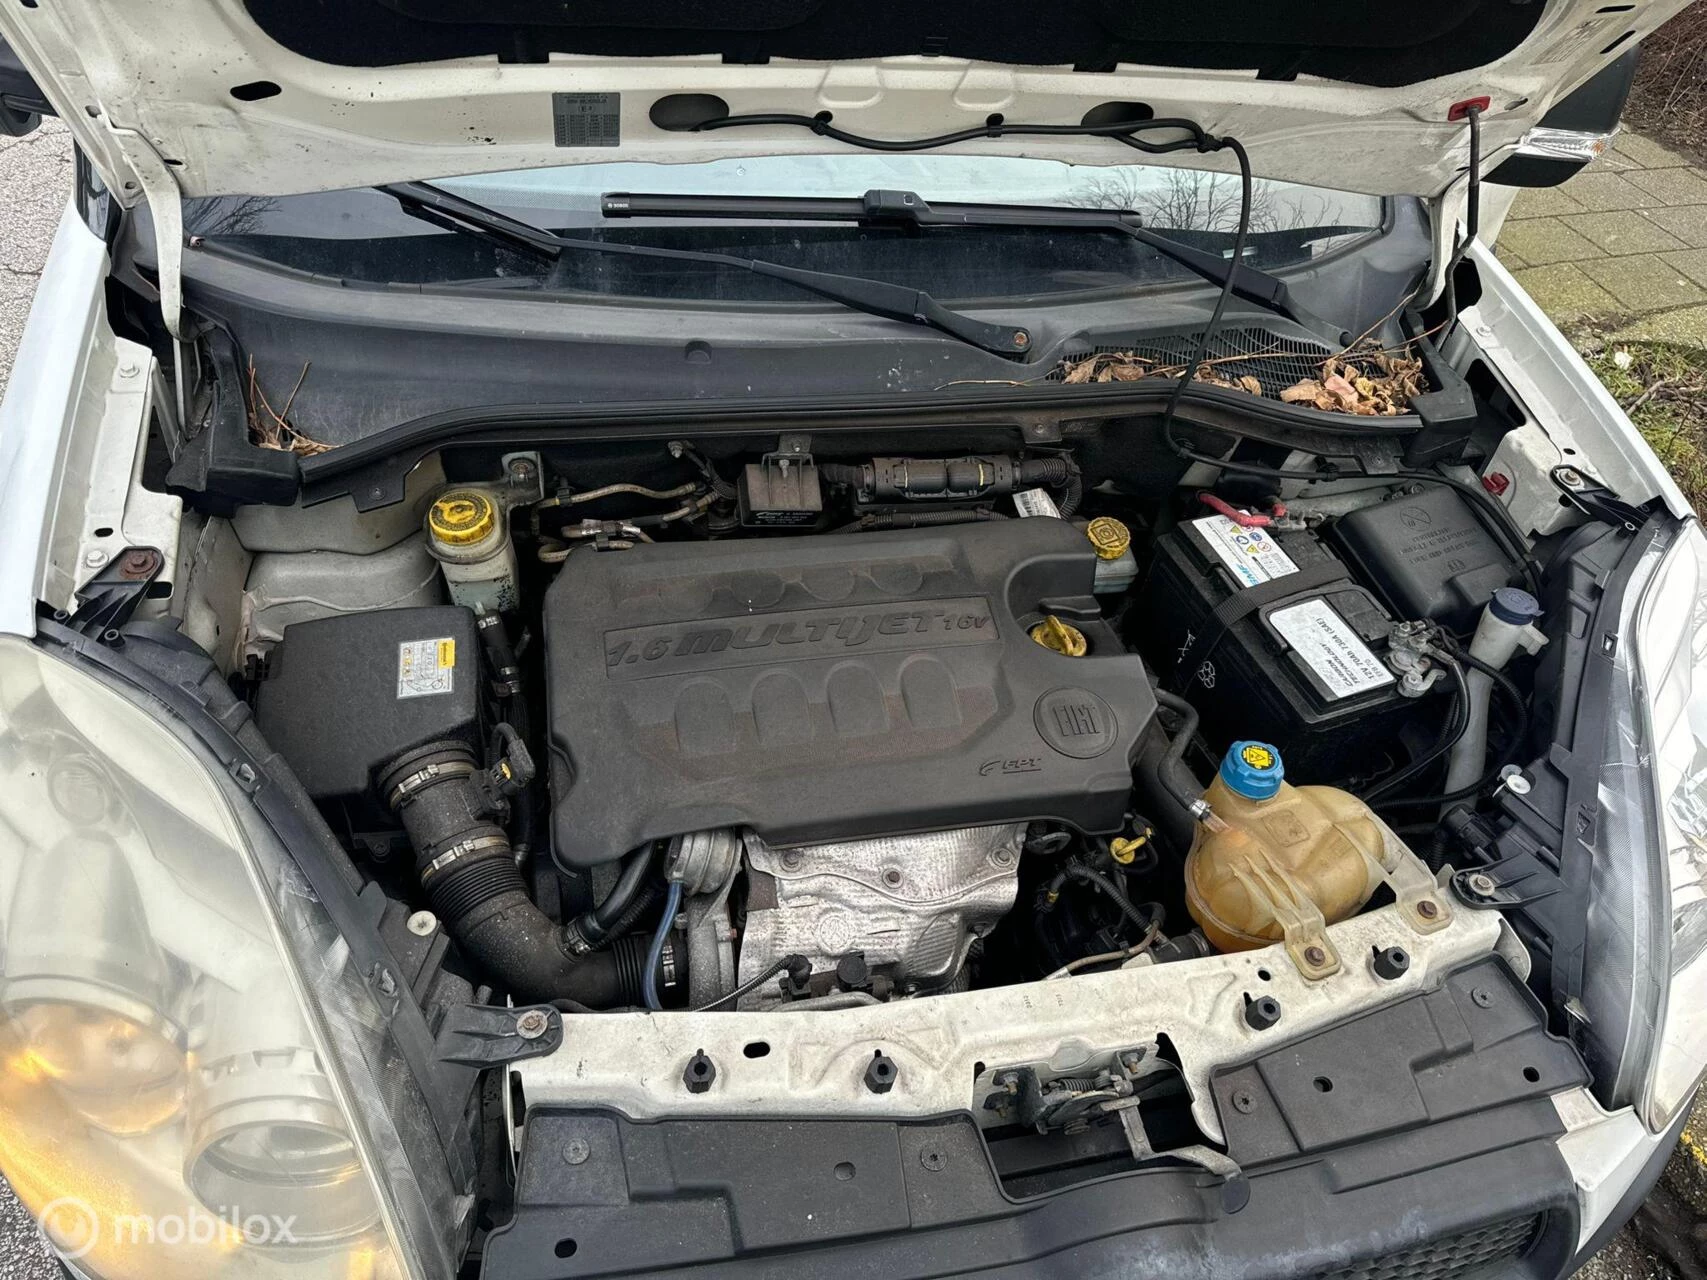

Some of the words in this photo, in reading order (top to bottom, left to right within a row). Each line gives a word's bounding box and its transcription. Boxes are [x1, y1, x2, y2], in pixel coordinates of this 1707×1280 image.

[607, 636, 672, 667] 1.6
[1332, 634, 1349, 651] 730A
[1320, 642, 1360, 684] TECHNOLOGY
[1326, 659, 1354, 687] CARBON
[1361, 667, 1375, 680] 12V
[1052, 704, 1101, 736] FIAT
